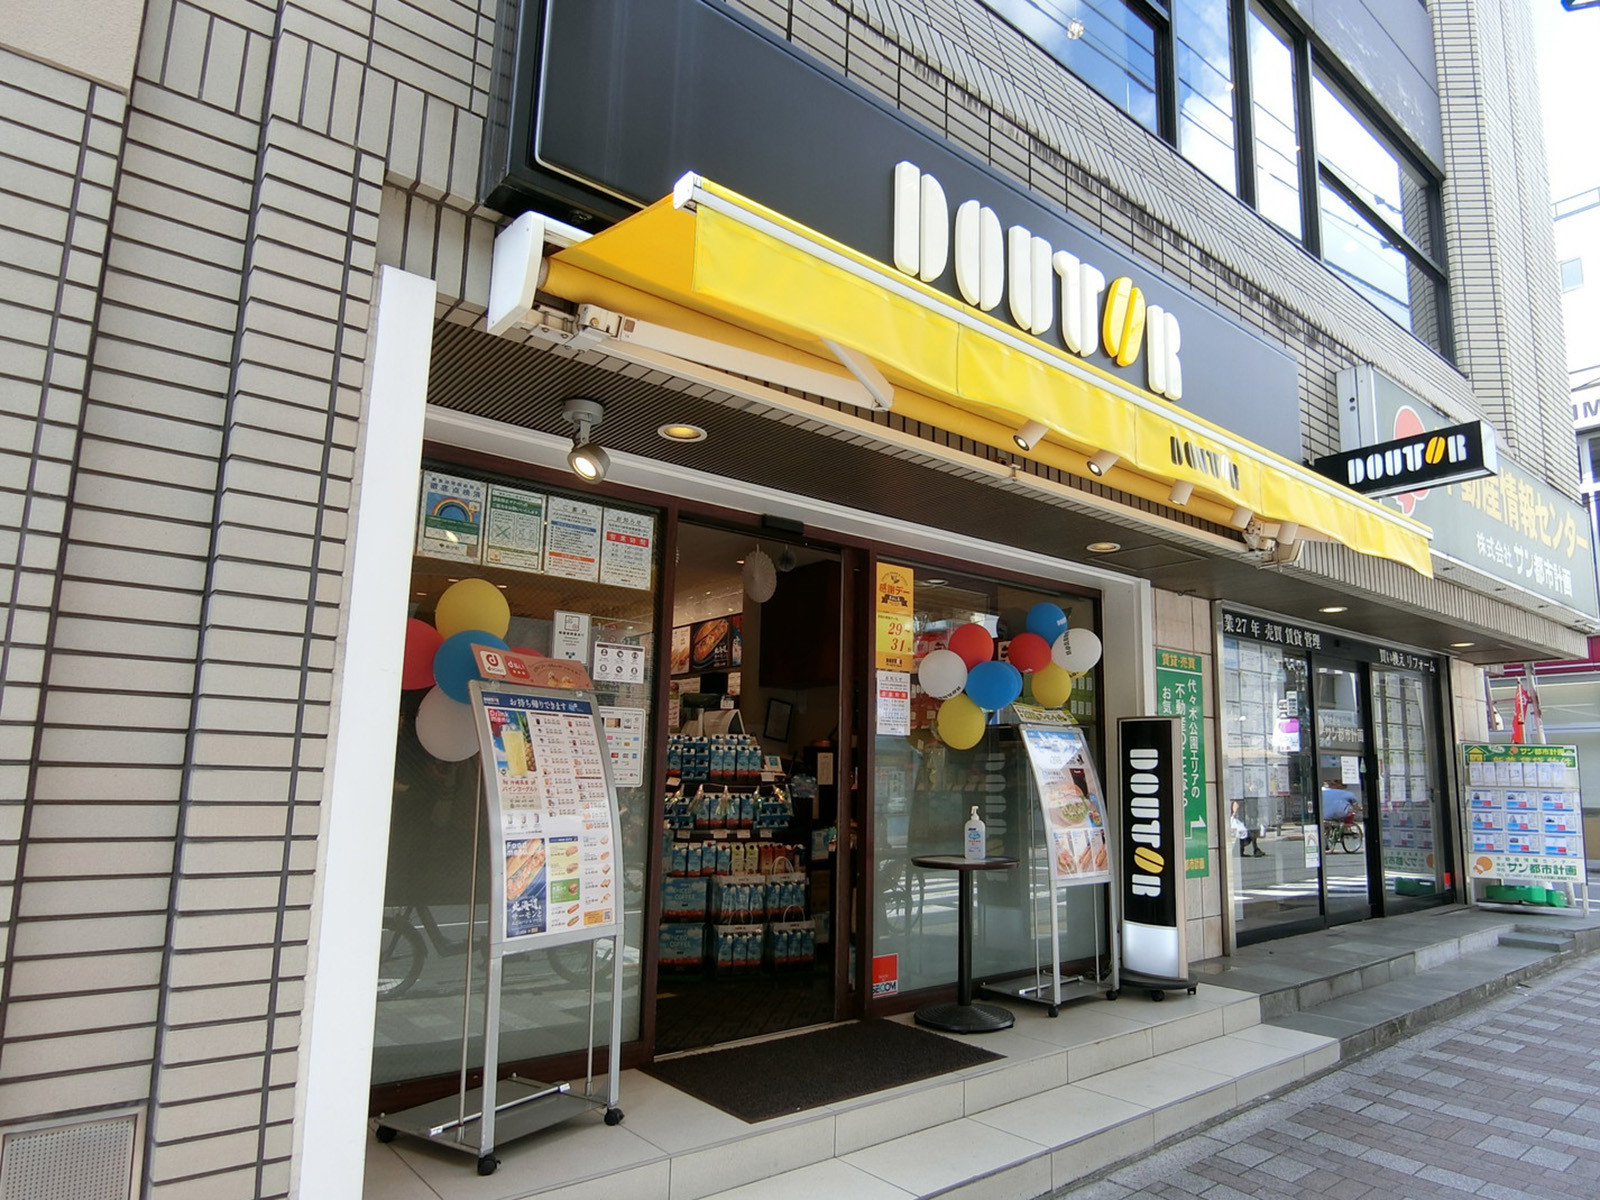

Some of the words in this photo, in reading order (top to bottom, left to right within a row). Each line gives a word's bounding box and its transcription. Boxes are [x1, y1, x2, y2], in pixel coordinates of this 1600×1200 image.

[893, 161, 1183, 401] DOUTOR
[1169, 436, 1240, 491] DOUTOR
[1347, 434, 1468, 485] DOUTOR
[1446, 466, 1589, 559] 動産情報センター
[879, 583, 910, 595] 感謝デー
[1476, 531, 1513, 568] 株式会社
[1513, 543, 1573, 598] サン都市計画
[1264, 623, 1283, 643] 売買
[1285, 627, 1303, 647] 賃貸
[1303, 631, 1321, 650] 管理
[1406, 655, 1436, 673] リフォーム
[489, 709, 508, 717] Drink
[509, 697, 567, 712] お持ち帰りできます
[1187, 679, 1201, 798] 代々木公園エリアの
[1129, 749, 1165, 897] DOUTOR
[1506, 862, 1577, 876] サン都市計画
